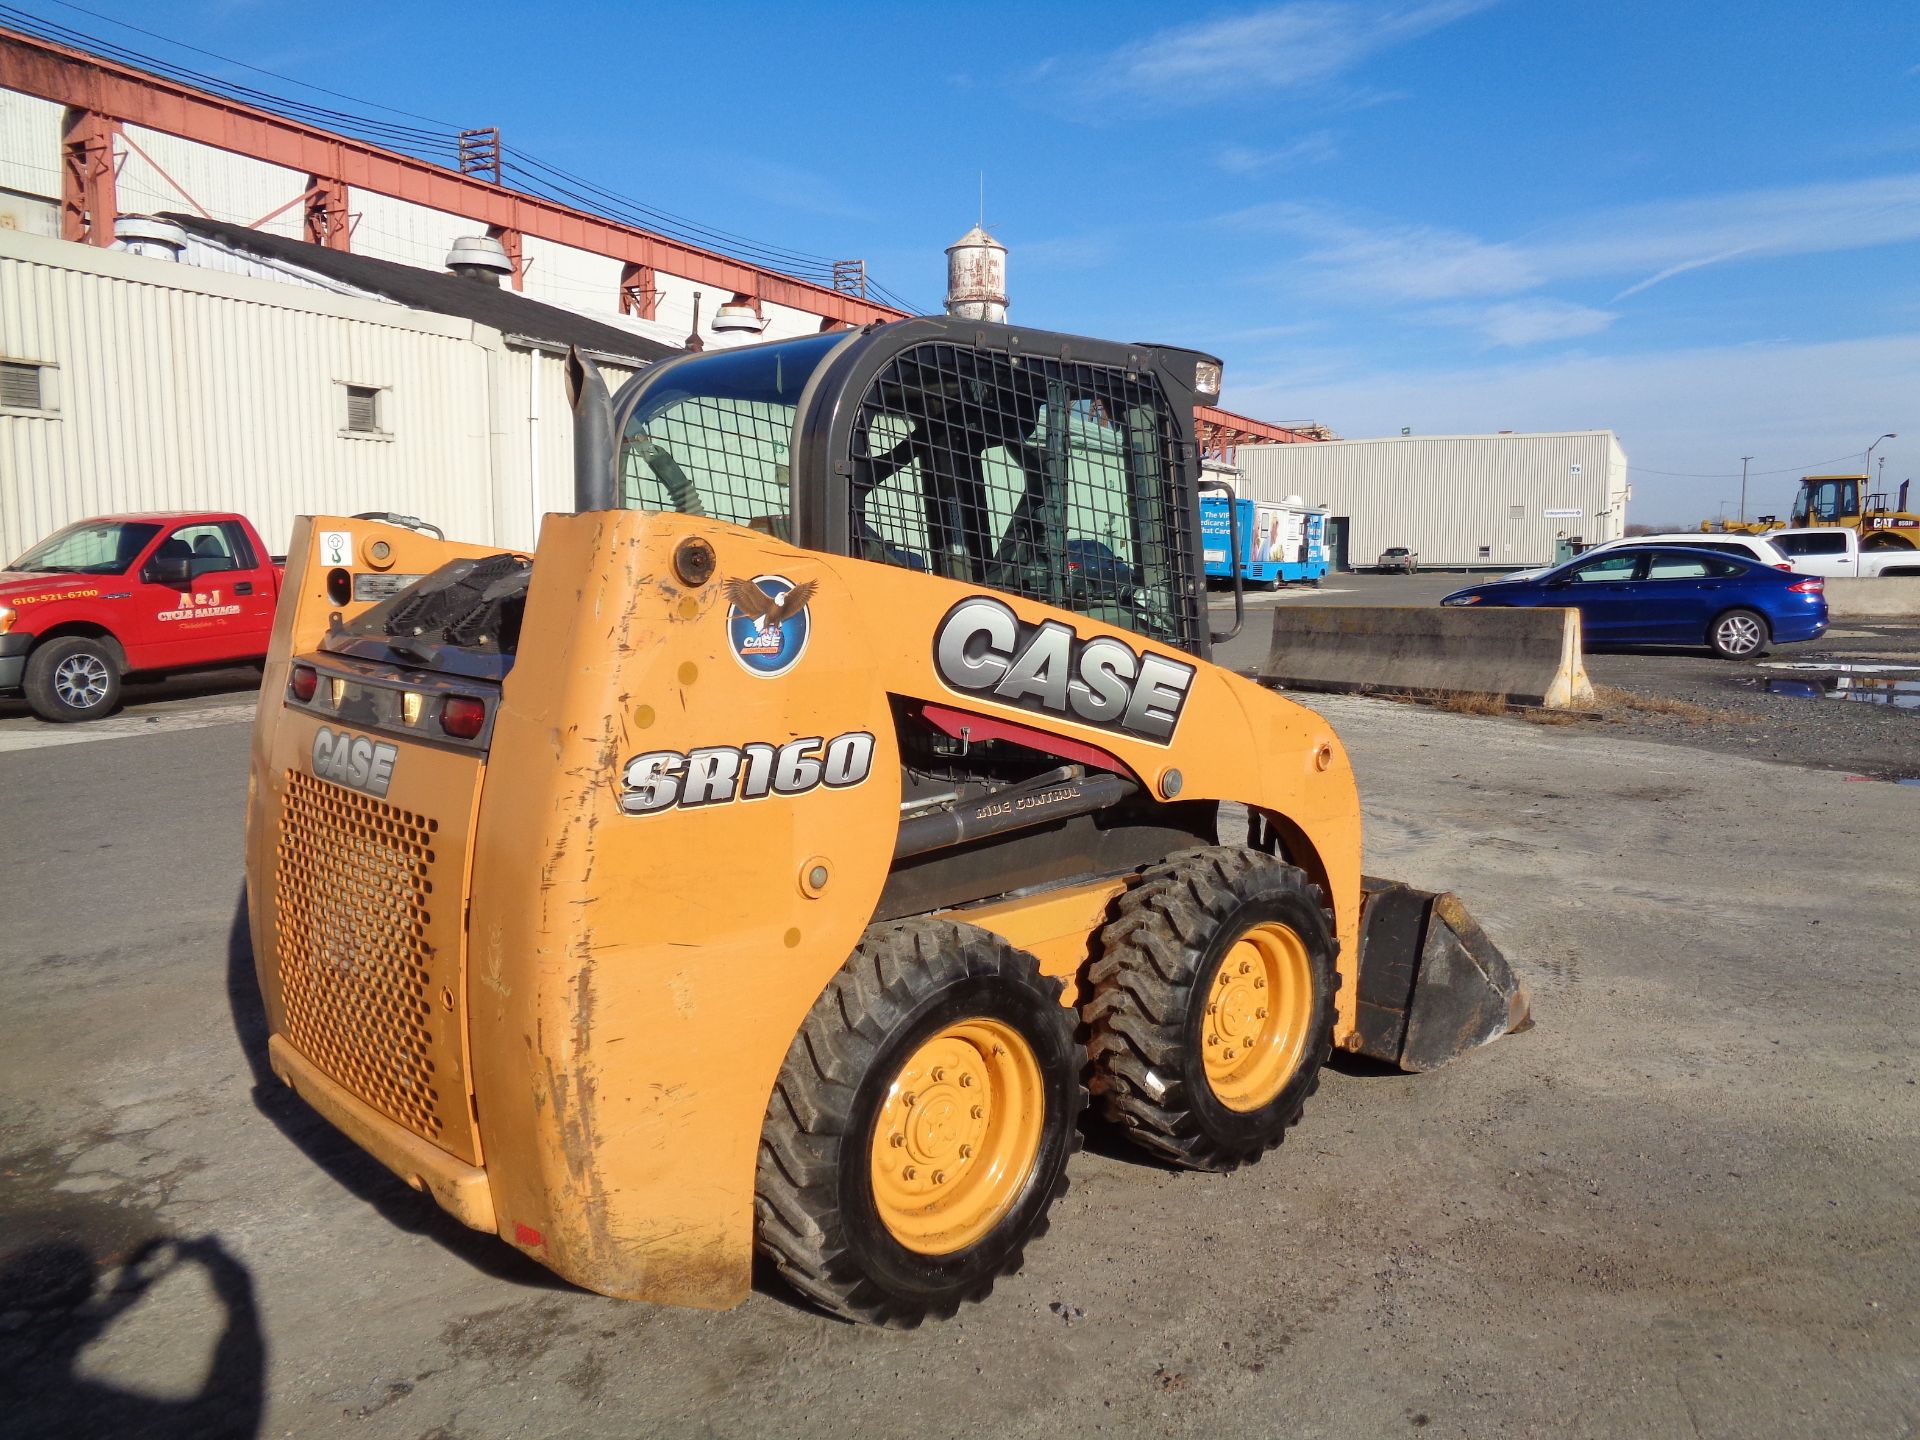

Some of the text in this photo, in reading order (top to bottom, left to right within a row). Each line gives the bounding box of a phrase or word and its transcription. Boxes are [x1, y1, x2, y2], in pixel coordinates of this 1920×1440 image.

[1873, 518, 1894, 528] CAT
[12, 589, 98, 606] 610-521-6700
[178, 590, 220, 609] A & J
[158, 605, 240, 622] CYCLE SALVAGE
[743, 635, 781, 648] CASE
[934, 595, 1197, 745] CASE
[312, 726, 398, 799] CASE
[621, 731, 876, 815] SR160
[975, 788, 1081, 819] RIDE CONTROL
